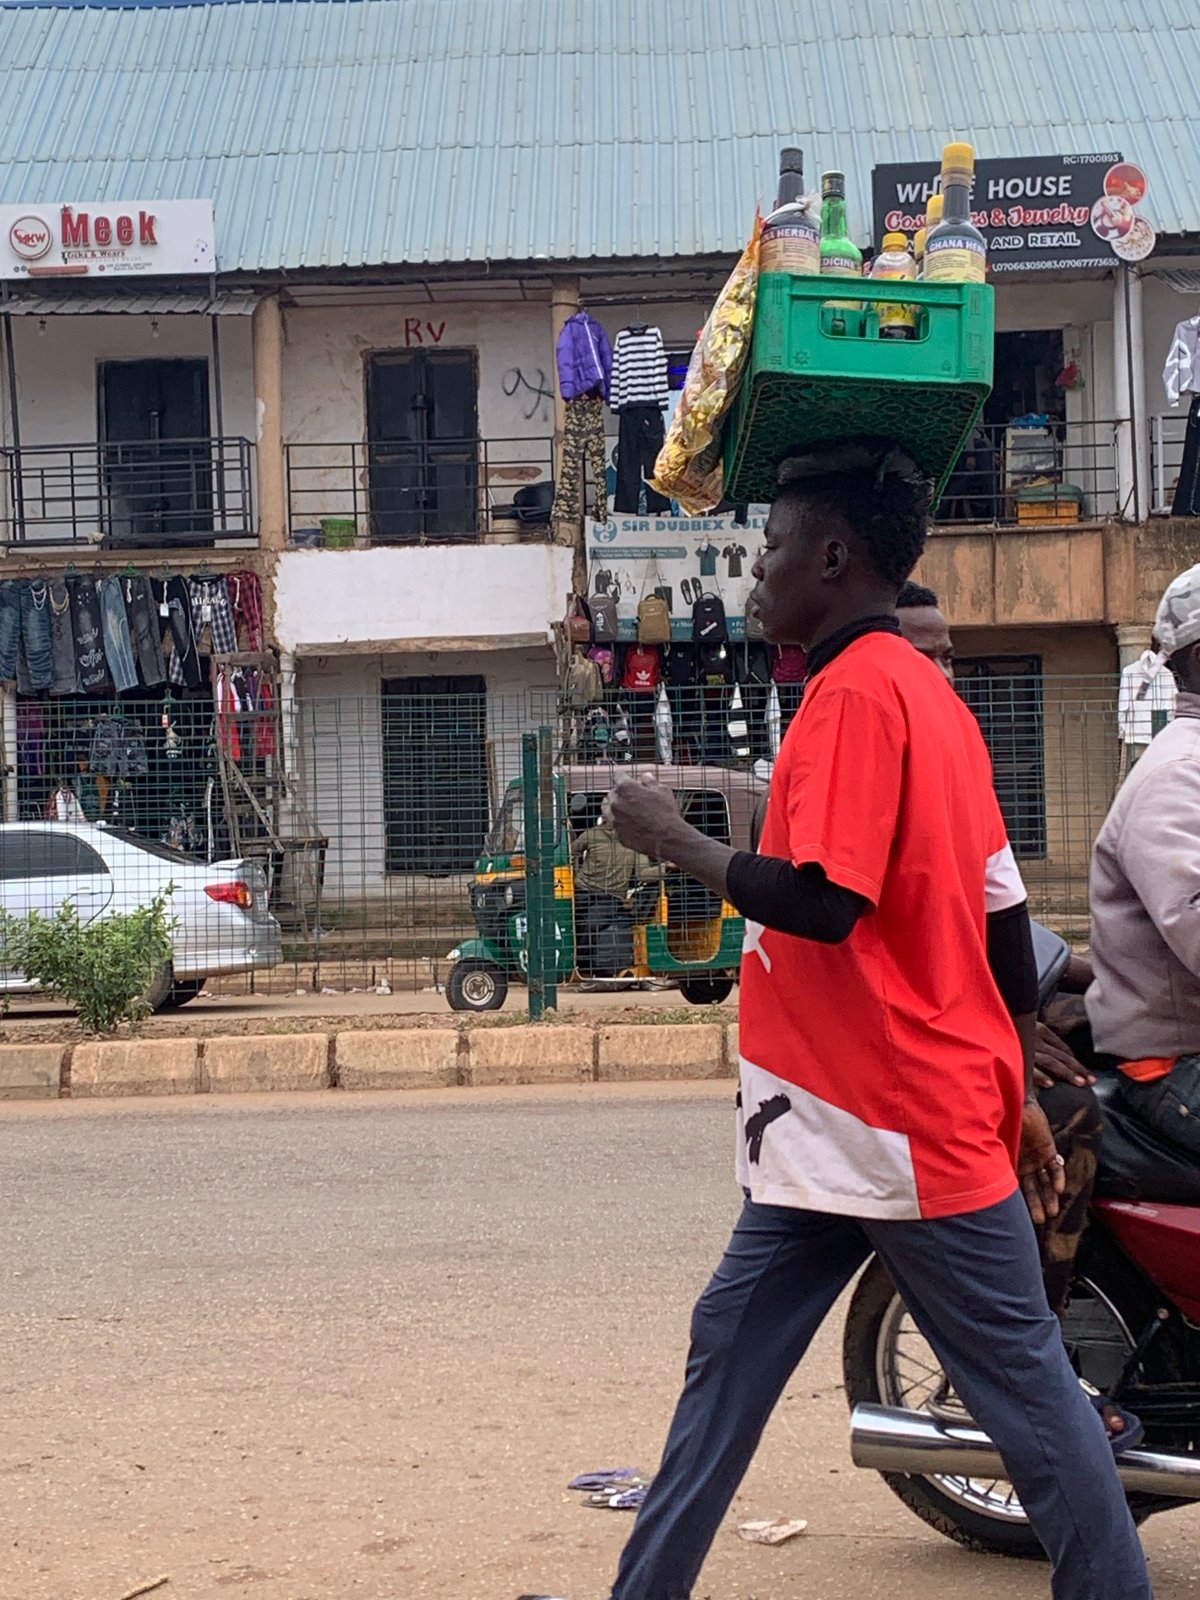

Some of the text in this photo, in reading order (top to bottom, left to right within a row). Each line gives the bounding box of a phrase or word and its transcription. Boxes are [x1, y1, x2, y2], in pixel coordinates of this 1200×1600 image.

[988, 174, 1072, 200] HOUSE
[991, 207, 1007, 228] &
[1007, 203, 1090, 227] Jewelry
[61, 210, 158, 247] Meek
[777, 228, 815, 242] HERBAL
[929, 239, 964, 252] GHANA
[990, 232, 1082, 250] AND RETAIL
[655, 520, 724, 532] DUBBEX
